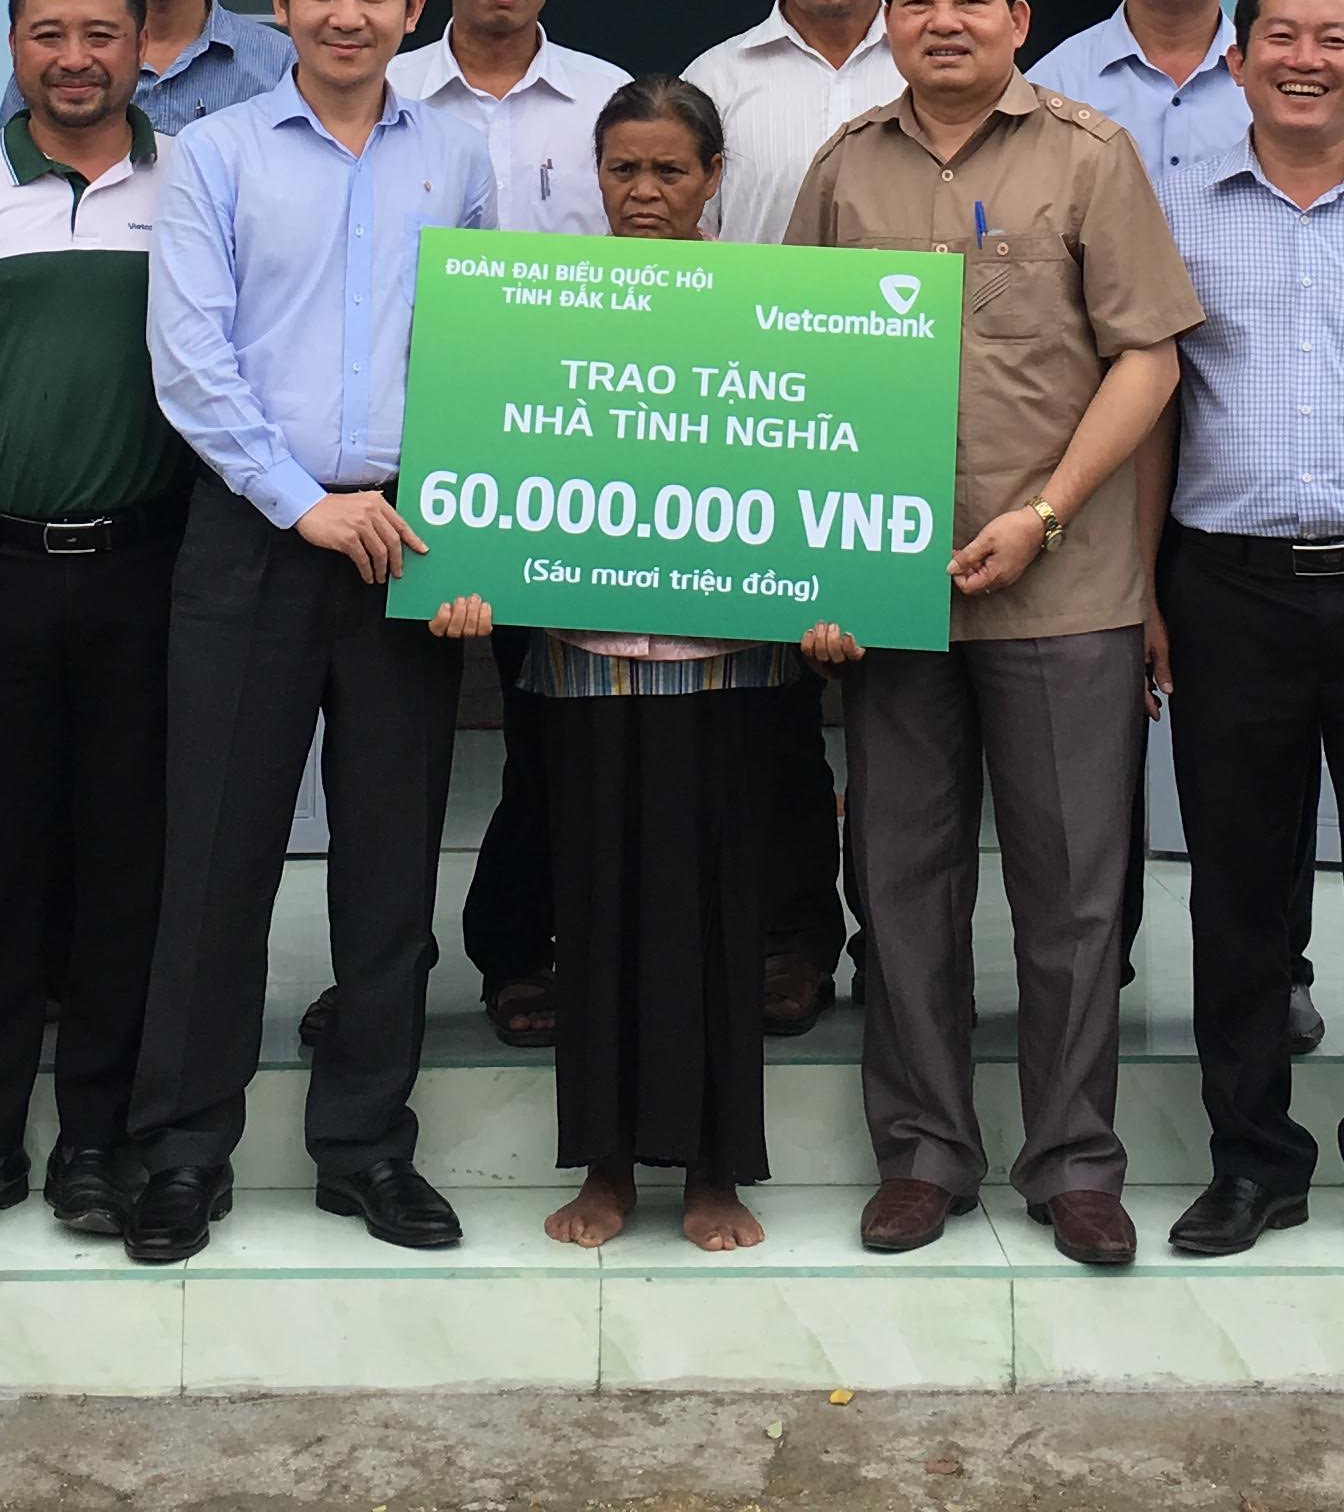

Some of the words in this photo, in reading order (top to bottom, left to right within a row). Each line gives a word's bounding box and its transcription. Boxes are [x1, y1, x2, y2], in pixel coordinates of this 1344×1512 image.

[445, 254, 505, 280] ĐOÀN
[512, 261, 549, 285] ĐẠI
[555, 259, 604, 284] BIỂU
[609, 261, 669, 288] QUỐC
[675, 266, 714, 293] HỘI
[502, 283, 553, 307] TỈNH
[560, 284, 606, 309] ĐẮK
[610, 287, 653, 312] LẮK
[755, 305, 936, 339] Vietcombank
[561, 359, 677, 396] TRAO
[692, 360, 807, 405] TẶNG
[503, 398, 594, 438] NHÀ
[609, 403, 709, 445] TÌNH
[726, 413, 860, 453] NGHĨA
[419, 470, 776, 546] 60.000.000
[798, 489, 935, 554] VNĐ
[522, 557, 582, 587] (Sáu
[591, 565, 660, 589] mươi
[669, 568, 733, 594] triệu
[742, 569, 820, 602] đồng)
